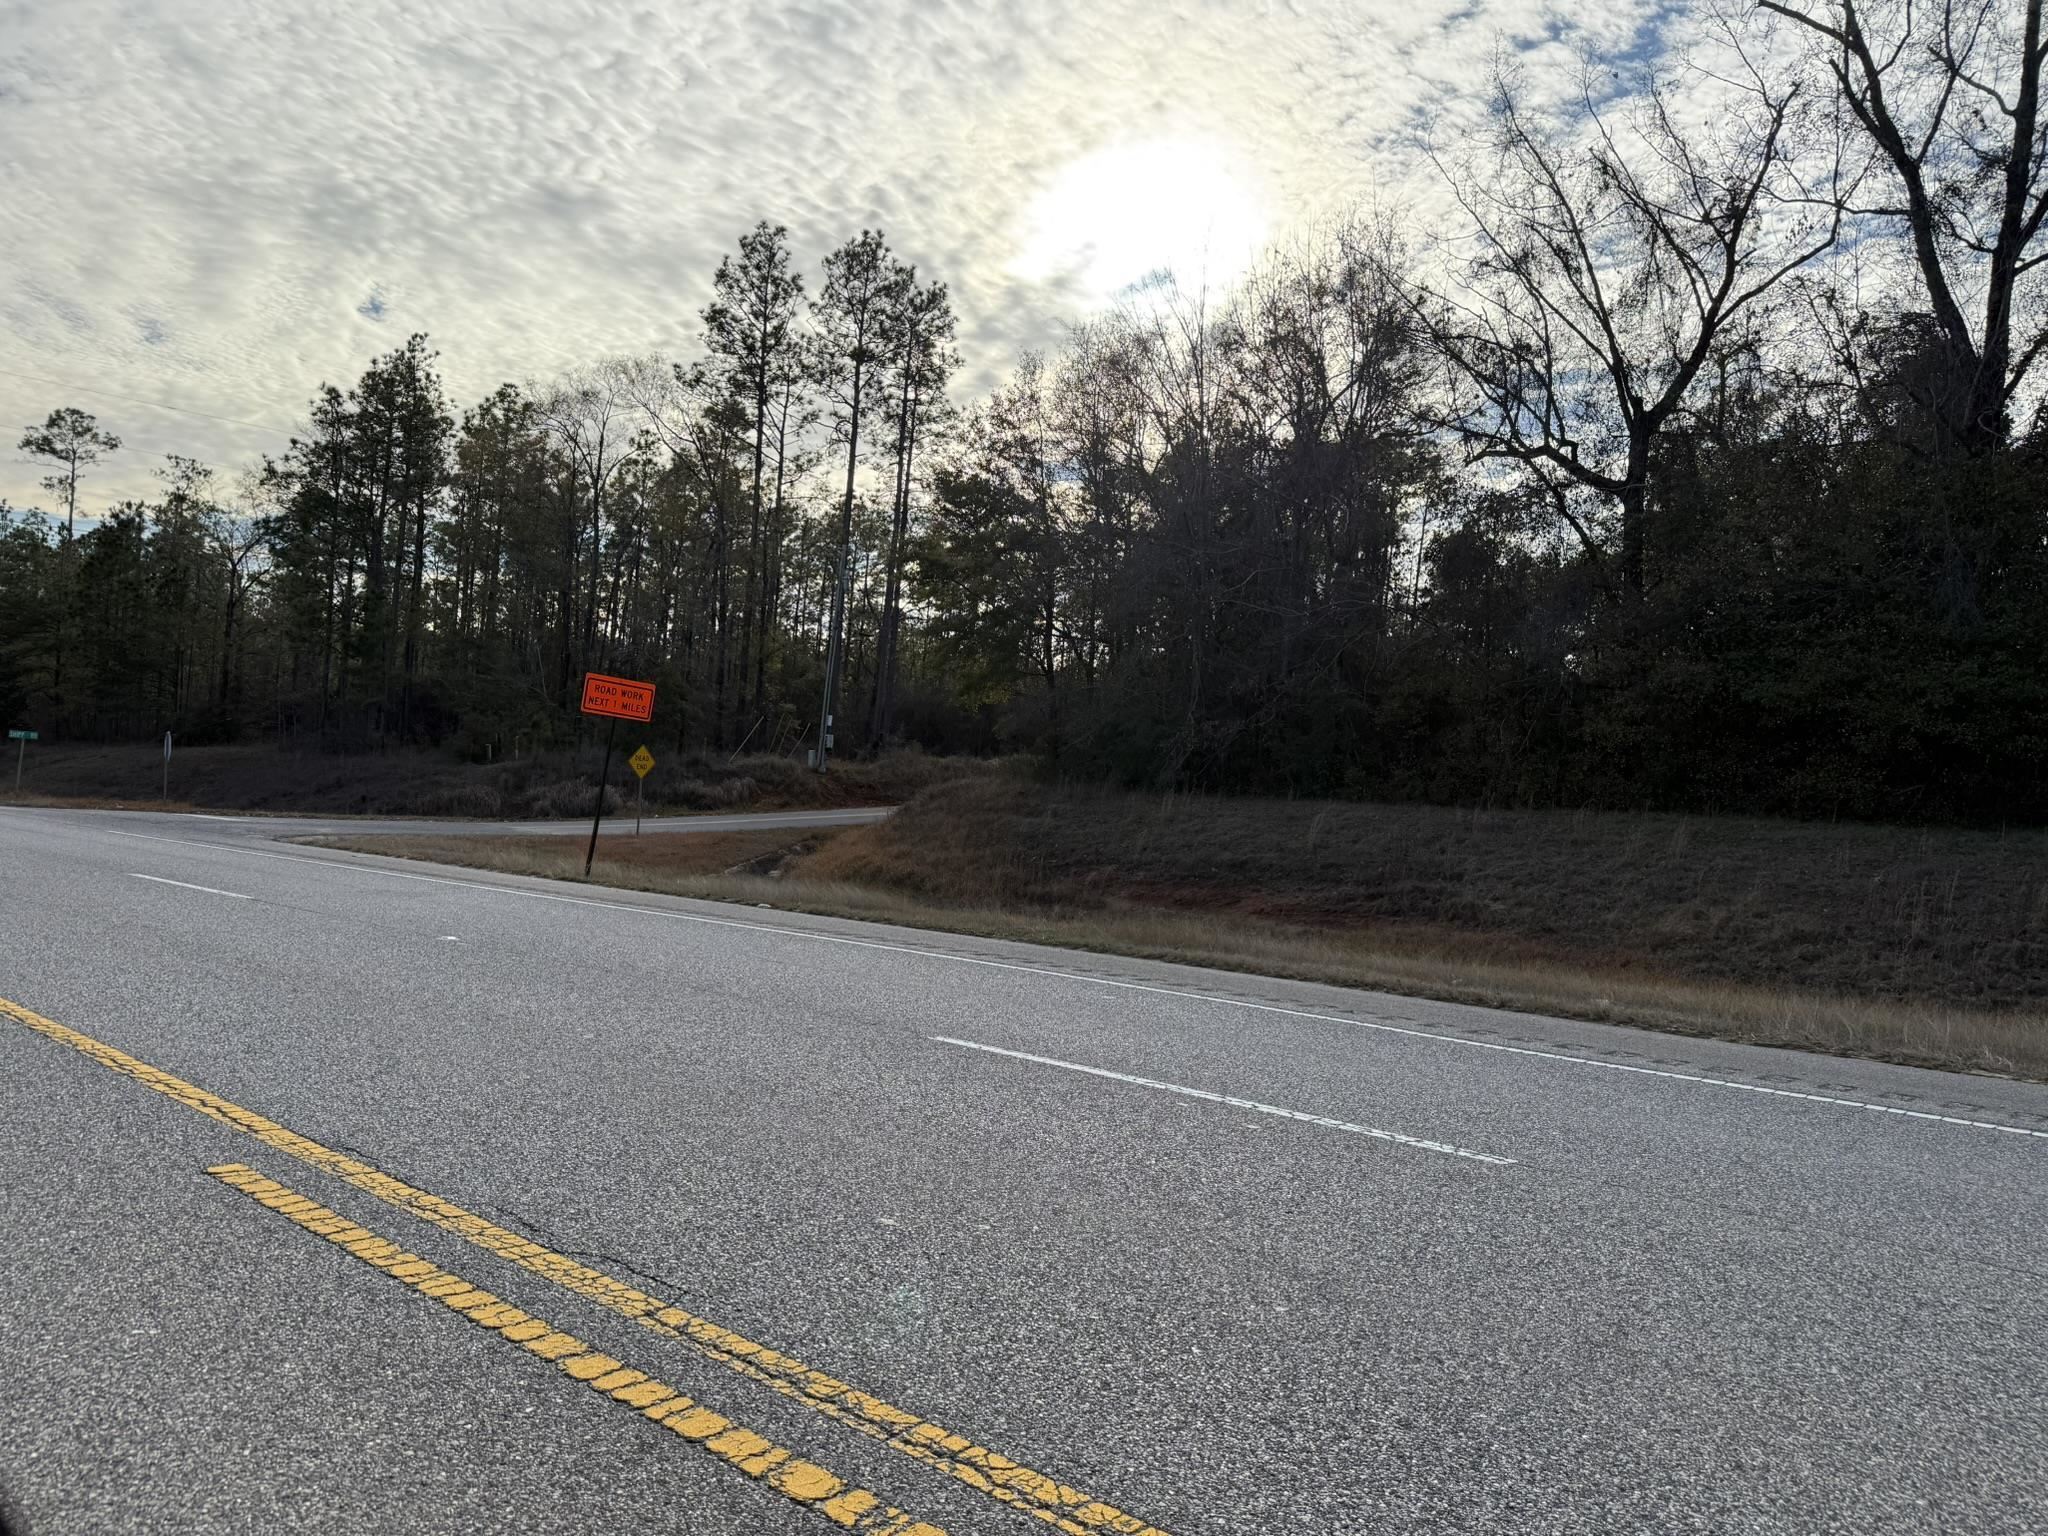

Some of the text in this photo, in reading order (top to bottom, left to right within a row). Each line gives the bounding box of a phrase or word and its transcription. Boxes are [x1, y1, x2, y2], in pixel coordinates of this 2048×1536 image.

[595, 685, 644, 701] ROAD WORK
[588, 696, 609, 707] NEXT
[621, 702, 647, 713] MILES
